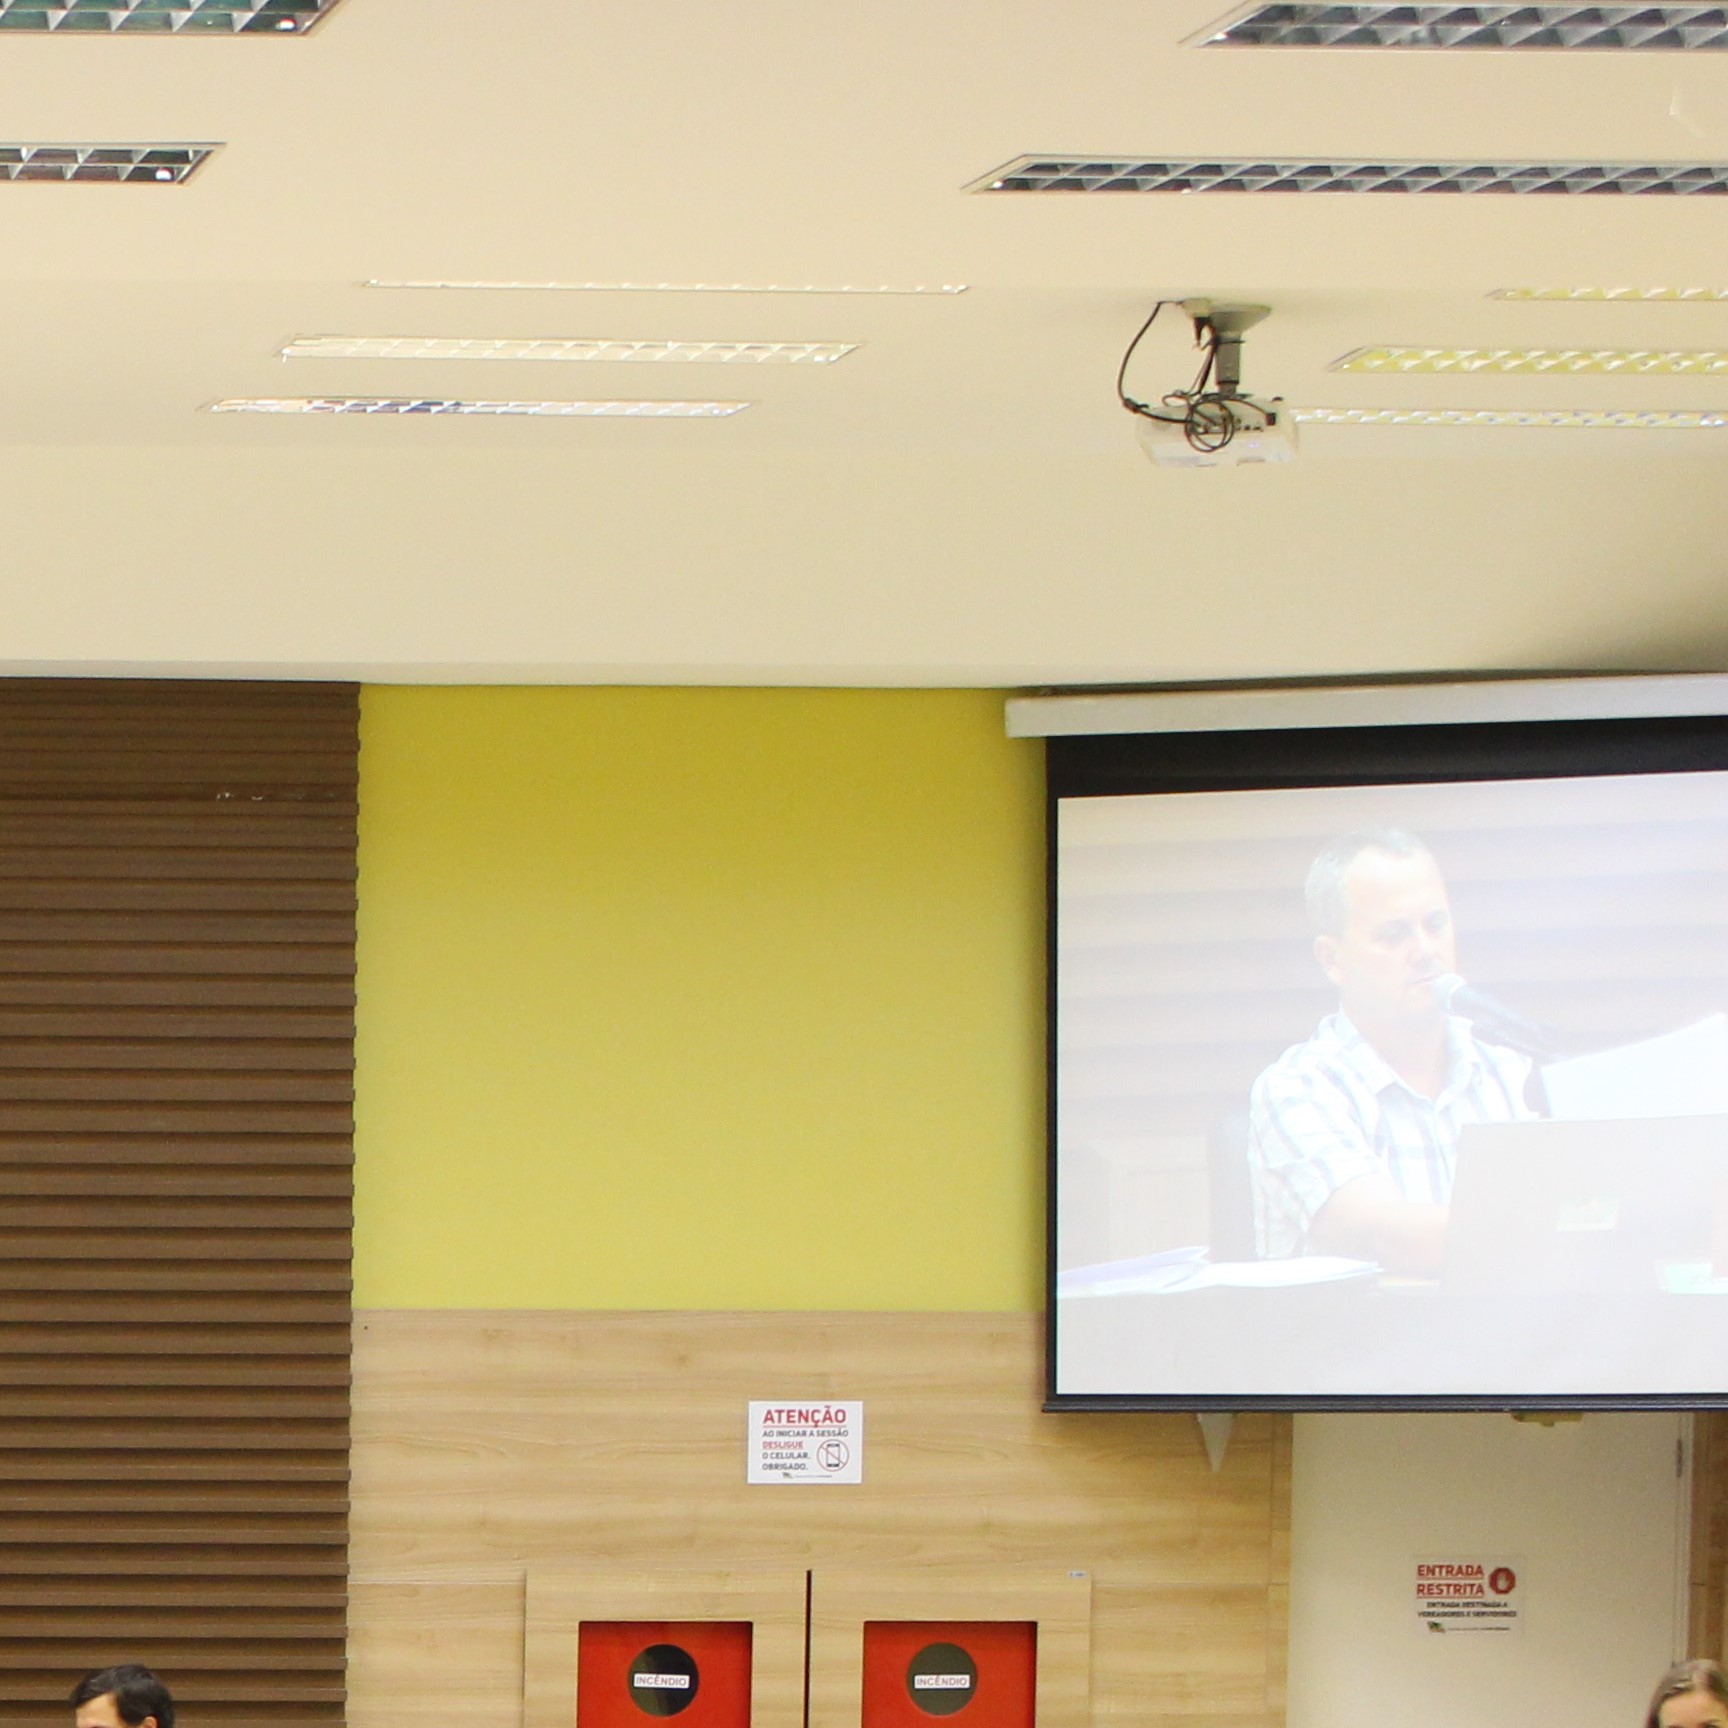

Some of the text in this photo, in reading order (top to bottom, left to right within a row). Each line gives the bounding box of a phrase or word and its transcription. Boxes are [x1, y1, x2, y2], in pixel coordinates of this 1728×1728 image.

[762, 1405, 846, 1428] ATENÇÃO
[816, 1428, 849, 1437] SESSÃO
[762, 1441, 804, 1450] DESLIGUE
[770, 1452, 811, 1460] CELULAR.
[762, 1463, 808, 1471] OBRIGADO.
[1417, 1564, 1484, 1577] ENTRADA
[1416, 1584, 1485, 1596] RESTRITA
[636, 1674, 687, 1686] INCÊNDIO
[916, 1674, 968, 1686] INCÊNDIO
